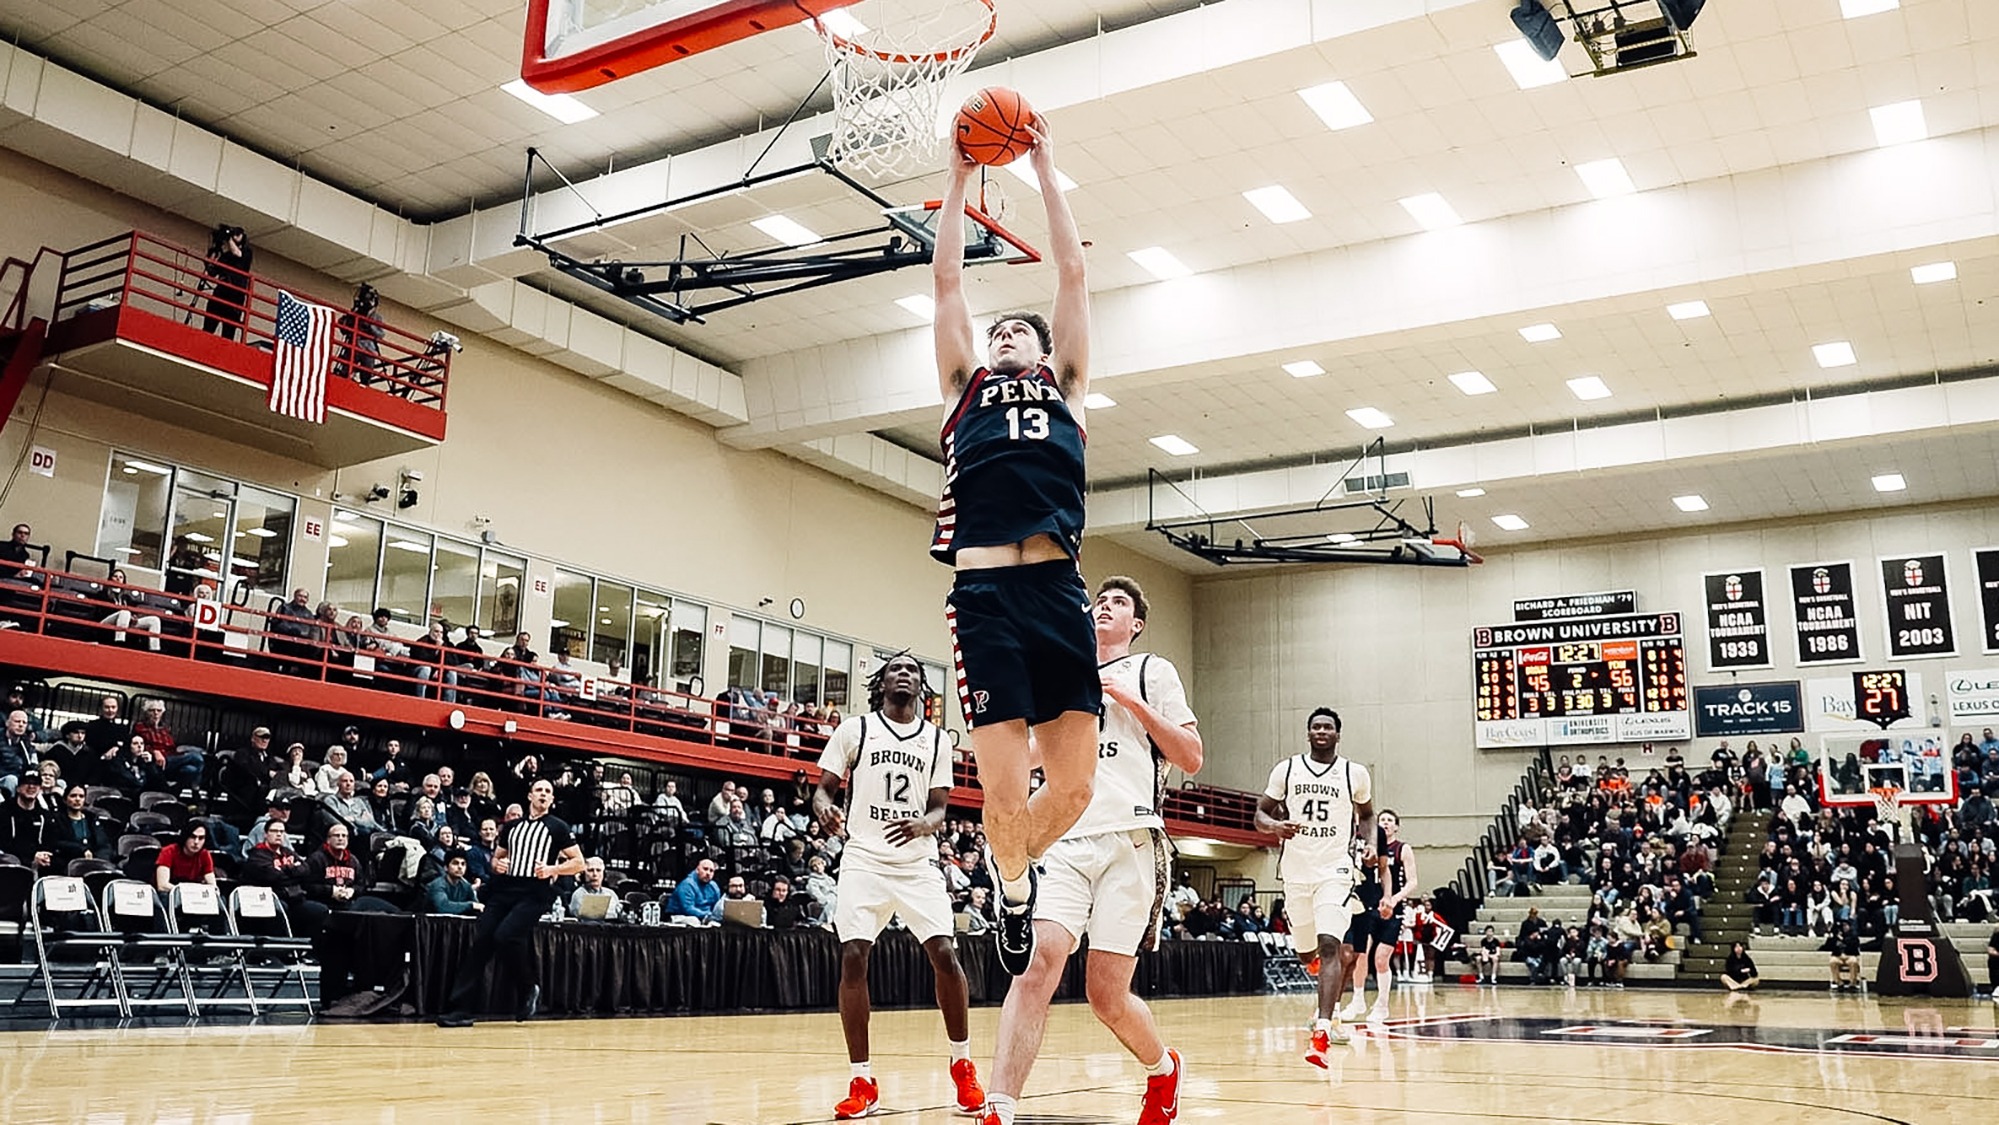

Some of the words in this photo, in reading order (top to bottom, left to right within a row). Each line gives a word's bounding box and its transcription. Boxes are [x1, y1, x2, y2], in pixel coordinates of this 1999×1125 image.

[1005, 407, 1050, 440] 13
[32, 451, 54, 469] DD
[305, 521, 321, 536] EE
[534, 580, 547, 593] EE
[1515, 600, 1554, 611] RICHARD
[1557, 600, 1567, 608] A.
[1569, 595, 1615, 606] FRIEDMAN
[1542, 605, 1602, 617] SCOREBOARD
[1904, 602, 1931, 620] NIT
[198, 605, 217, 626] D
[1719, 612, 1753, 627] NCAA
[1807, 606, 1843, 620] NCAA
[1494, 626, 1554, 643] BROWN
[1559, 619, 1657, 638] UNIVERSITY
[1660, 614, 1677, 634] B
[1710, 625, 1765, 638] TOURNAMENT
[1798, 618, 1855, 632] TOURNAMENT
[1476, 628, 1492, 647] B
[1808, 635, 1848, 653] 1986
[1899, 628, 1944, 647] 2003
[1559, 642, 1600, 662] 12:27
[1720, 641, 1758, 658] 1939
[584, 677, 594, 696] E
[1528, 675, 1550, 692] 45
[1572, 674, 1583, 688] 2
[1610, 669, 1633, 687] 56
[1862, 673, 1902, 688] 12:27
[973, 689, 990, 714] P
[1530, 697, 1539, 711] 3
[1546, 696, 1556, 711] 3
[1602, 693, 1612, 708] 3
[1624, 693, 1635, 705] 4
[1866, 689, 1899, 713] 27
[1952, 700, 1989, 711] LEXUS
[1705, 701, 1769, 717] TRACK
[1772, 701, 1792, 713] 15
[870, 750, 926, 774] BROWN
[883, 770, 910, 804] 12
[1294, 783, 1340, 799] BROWN
[1302, 799, 1329, 822] 45
[1297, 825, 1337, 838] EARS
[1897, 938, 1938, 983] B
